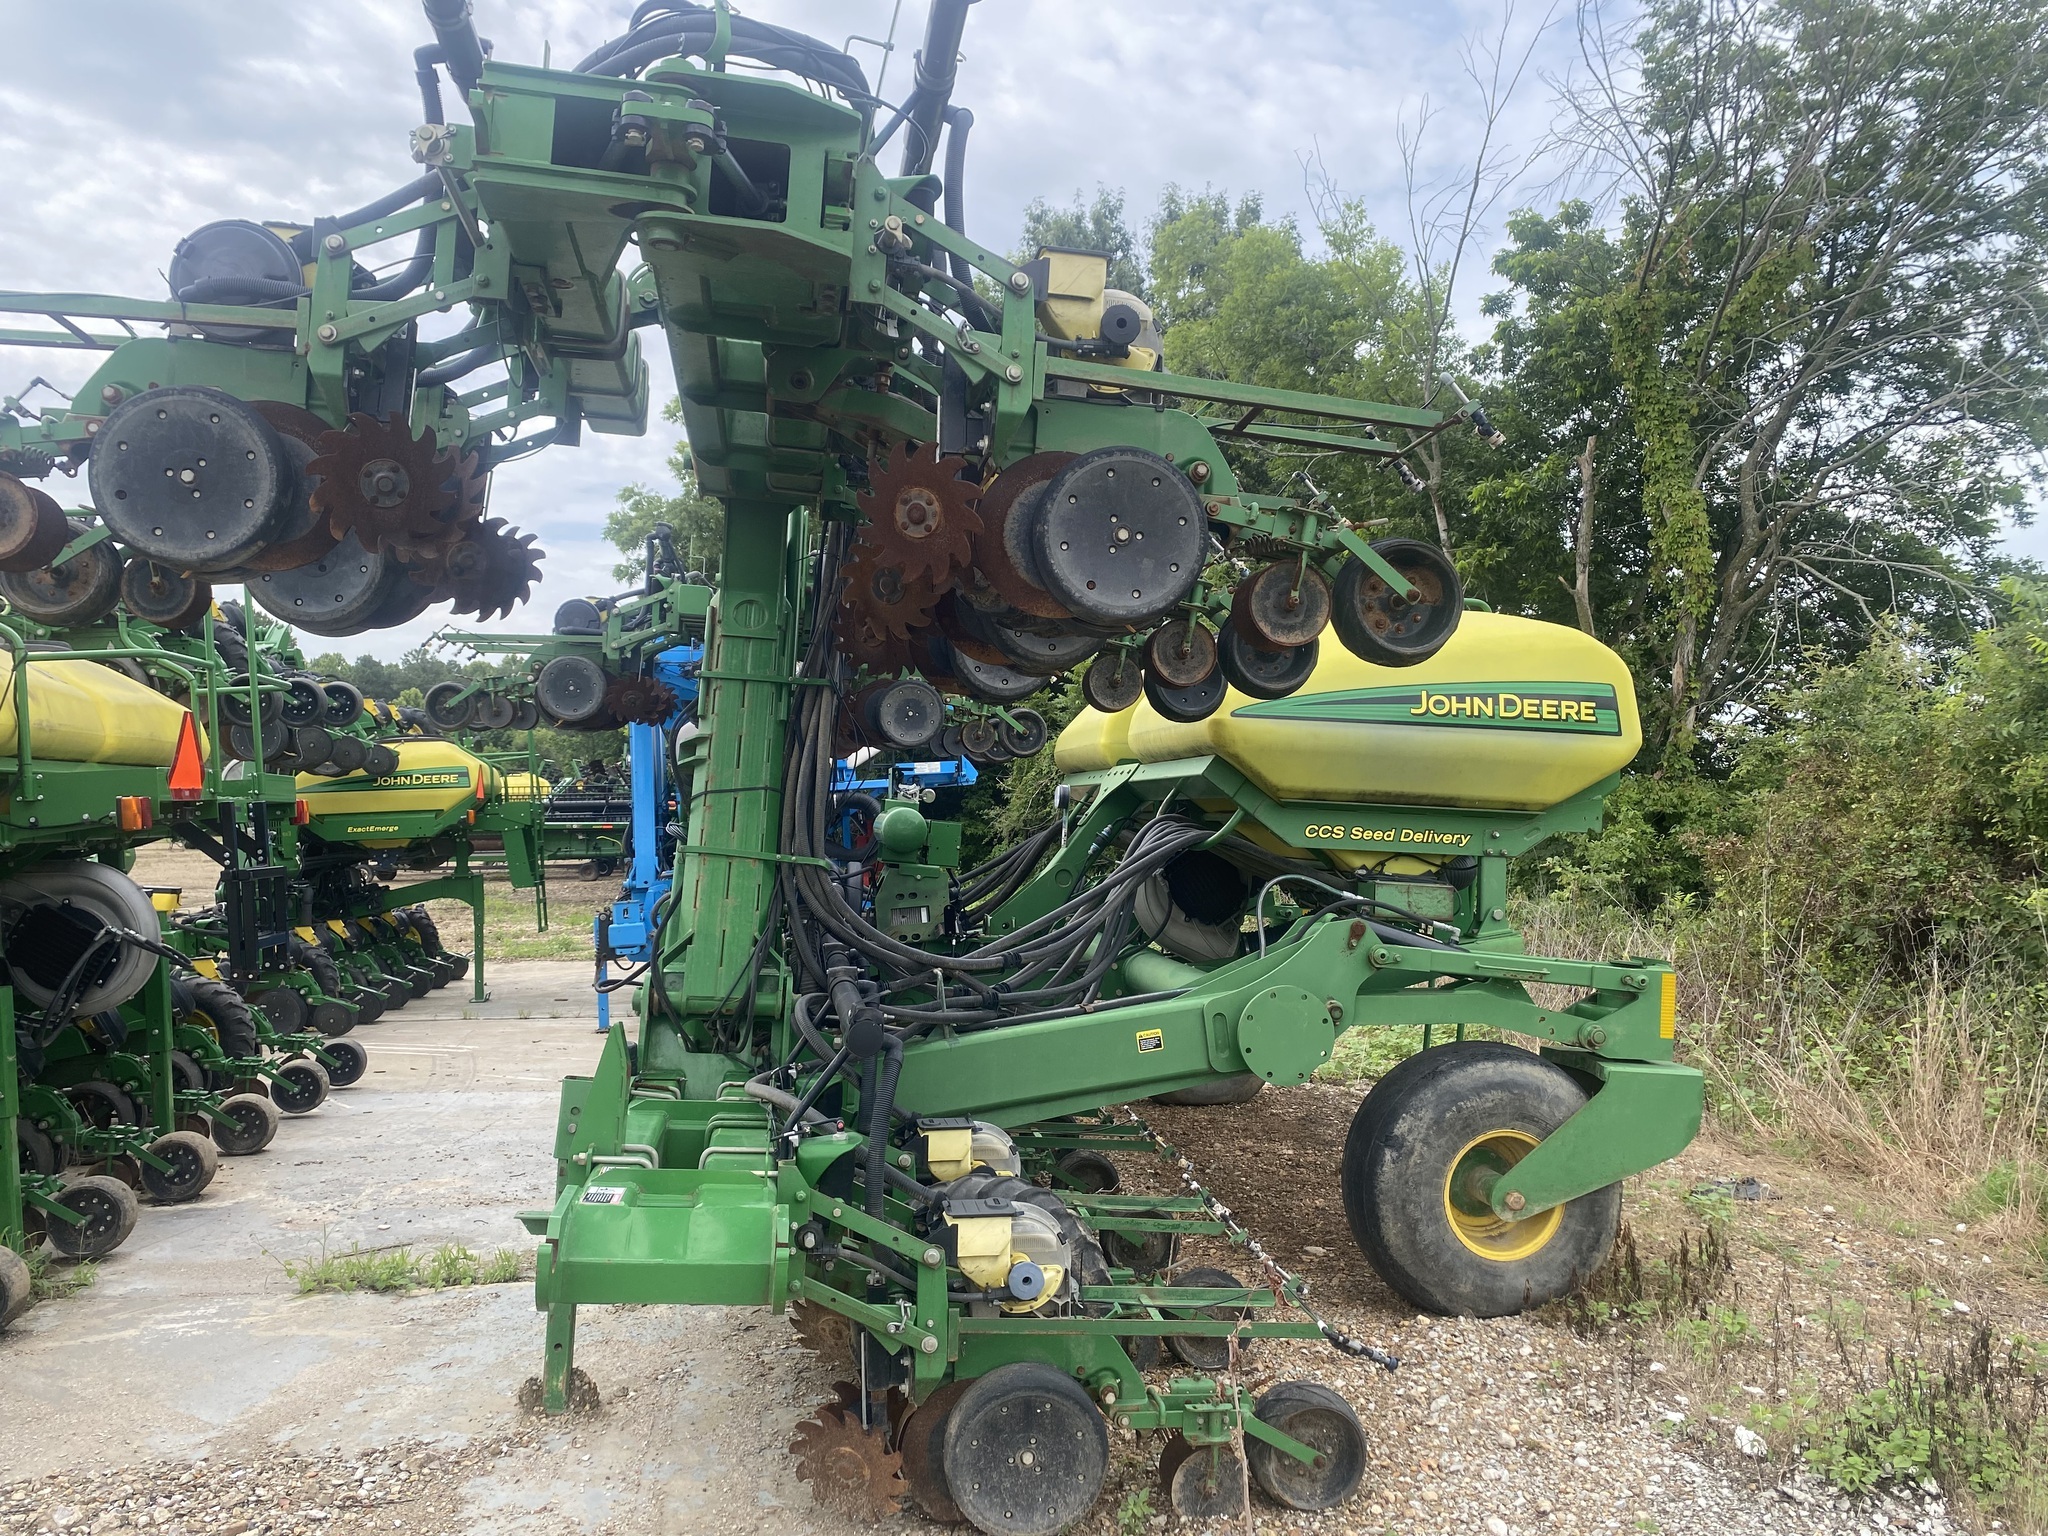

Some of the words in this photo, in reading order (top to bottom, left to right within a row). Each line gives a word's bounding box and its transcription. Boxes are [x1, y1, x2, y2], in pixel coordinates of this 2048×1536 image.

[1410, 690, 1493, 718] JOHN
[1498, 693, 1597, 721] DEERE
[372, 775, 410, 786] JOHN
[412, 774, 459, 785] DEERE
[347, 825, 399, 833] ExactEmerge
[1304, 824, 1345, 839] CCS
[1350, 826, 1396, 842] Seed
[1399, 828, 1472, 848] Delivery
